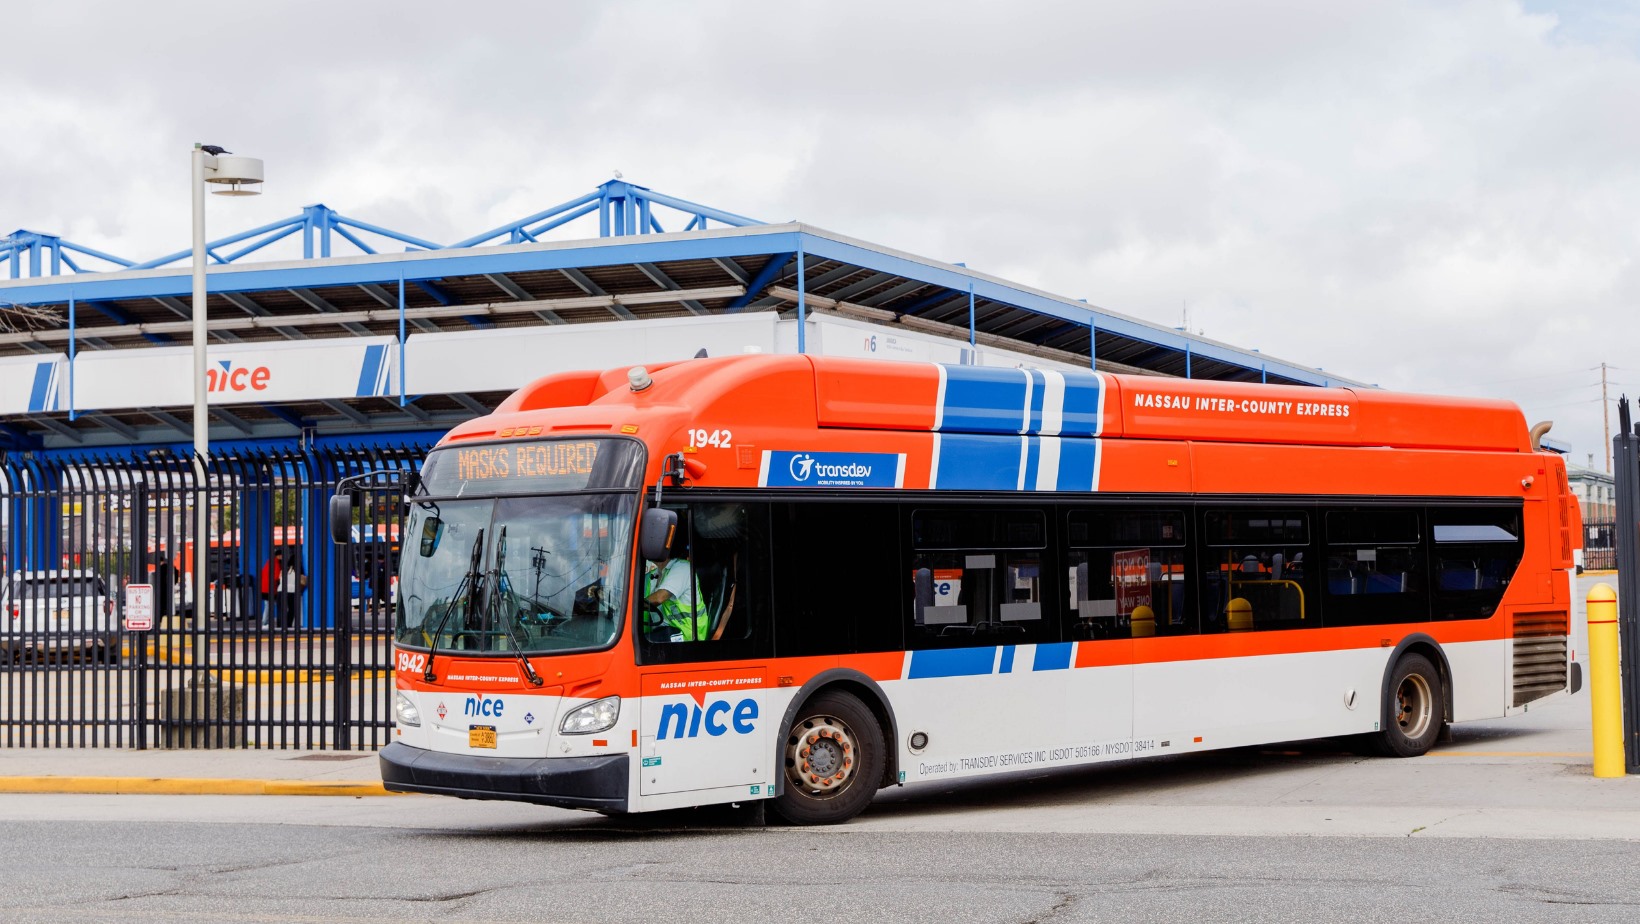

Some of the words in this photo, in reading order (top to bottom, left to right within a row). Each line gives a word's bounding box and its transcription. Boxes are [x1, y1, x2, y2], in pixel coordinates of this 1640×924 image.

[1135, 394, 1190, 409] NASSAU
[1195, 397, 1293, 415] INTER-COUNTY
[1296, 403, 1350, 417] EXPRESS
[688, 429, 732, 448] 1942
[458, 448, 509, 480] MASKS
[517, 442, 597, 476] REQUIRED
[815, 463, 872, 477] transdev
[398, 653, 424, 673] 1942
[688, 679, 734, 687] INTER-COUNTY
[465, 697, 504, 717] nice
[656, 698, 759, 740] nice
[919, 762, 948, 776] Operated
[949, 762, 959, 774] by:
[960, 755, 999, 770] TRANSDEV
[999, 752, 1032, 766] SERVICES
[1034, 751, 1046, 762] INC
[1049, 747, 1074, 760] USDOT
[1075, 745, 1100, 758] 505166
[1105, 742, 1133, 755] NYSDOT
[1134, 740, 1154, 752] 38414
